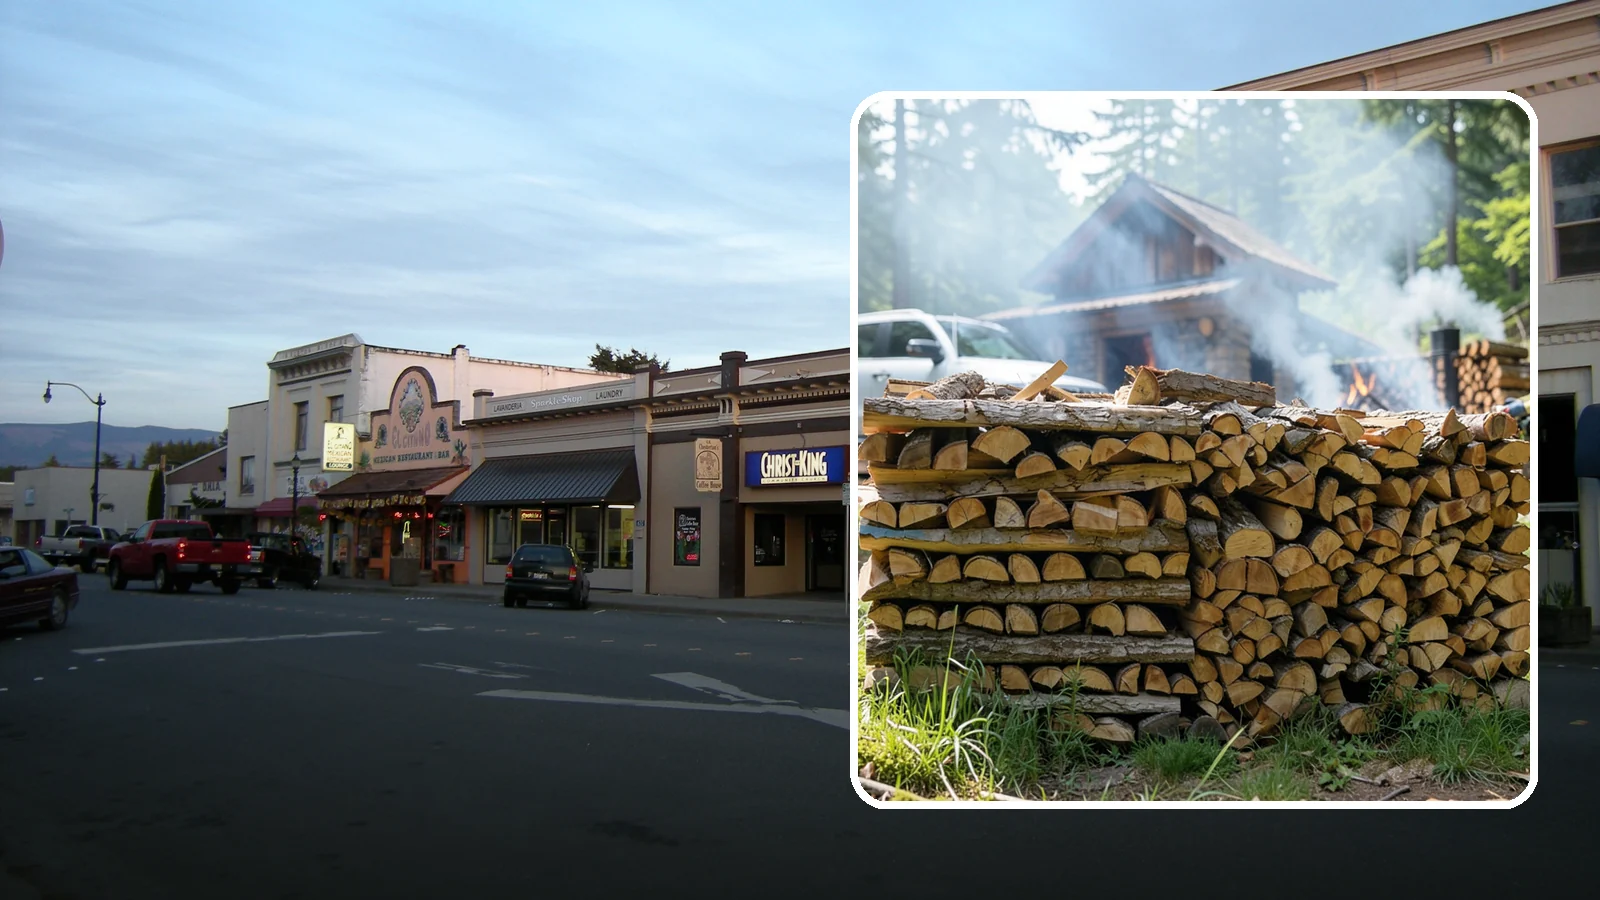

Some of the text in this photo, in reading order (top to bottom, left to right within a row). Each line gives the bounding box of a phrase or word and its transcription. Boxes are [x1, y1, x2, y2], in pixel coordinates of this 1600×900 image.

[595, 389, 623, 399] LAUNDRY
[493, 402, 523, 413] LAVANDERIA
[530, 394, 583, 409] Sparkle Shop
[373, 455, 396, 464] MEXICAN
[397, 452, 433, 462] RESTAURANT
[438, 451, 450, 459] BAR
[761, 450, 828, 478] CHRIST KING
